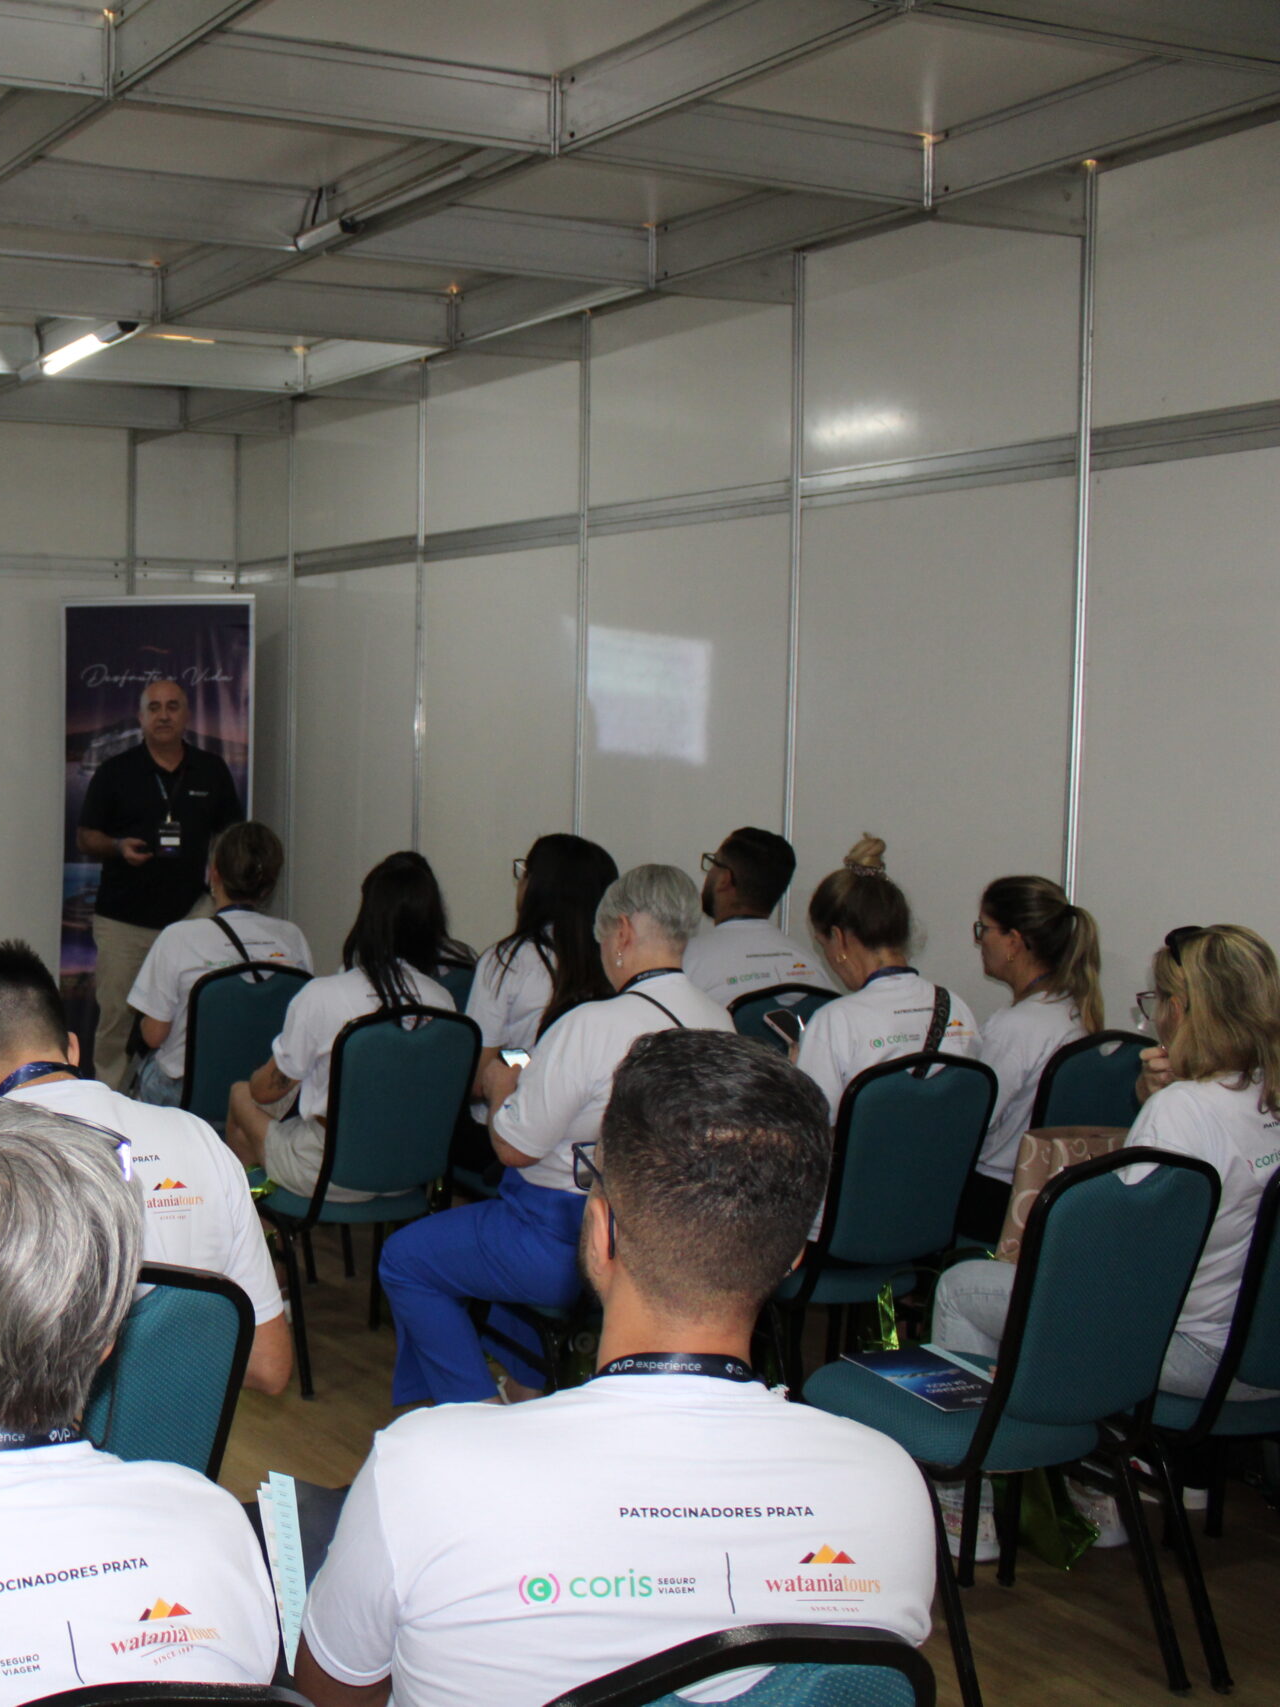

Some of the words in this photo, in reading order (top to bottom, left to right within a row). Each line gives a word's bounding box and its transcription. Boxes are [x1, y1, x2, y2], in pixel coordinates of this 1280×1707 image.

[132, 1154, 160, 1163] PRATA
[147, 1195, 204, 1208] ataniatours
[636, 1359, 702, 1372] experience
[619, 1506, 762, 1519] PATROCINADORES
[767, 1506, 815, 1518] PRATA
[102, 1557, 149, 1575] PRATA
[569, 1568, 653, 1598] coris
[658, 1577, 696, 1585] SEGURO
[765, 1573, 881, 1593] wataniatours
[658, 1586, 696, 1594] VIAGEM
[0, 1653, 40, 1667] SEGURO
[2, 1663, 41, 1676] VIAGEM
